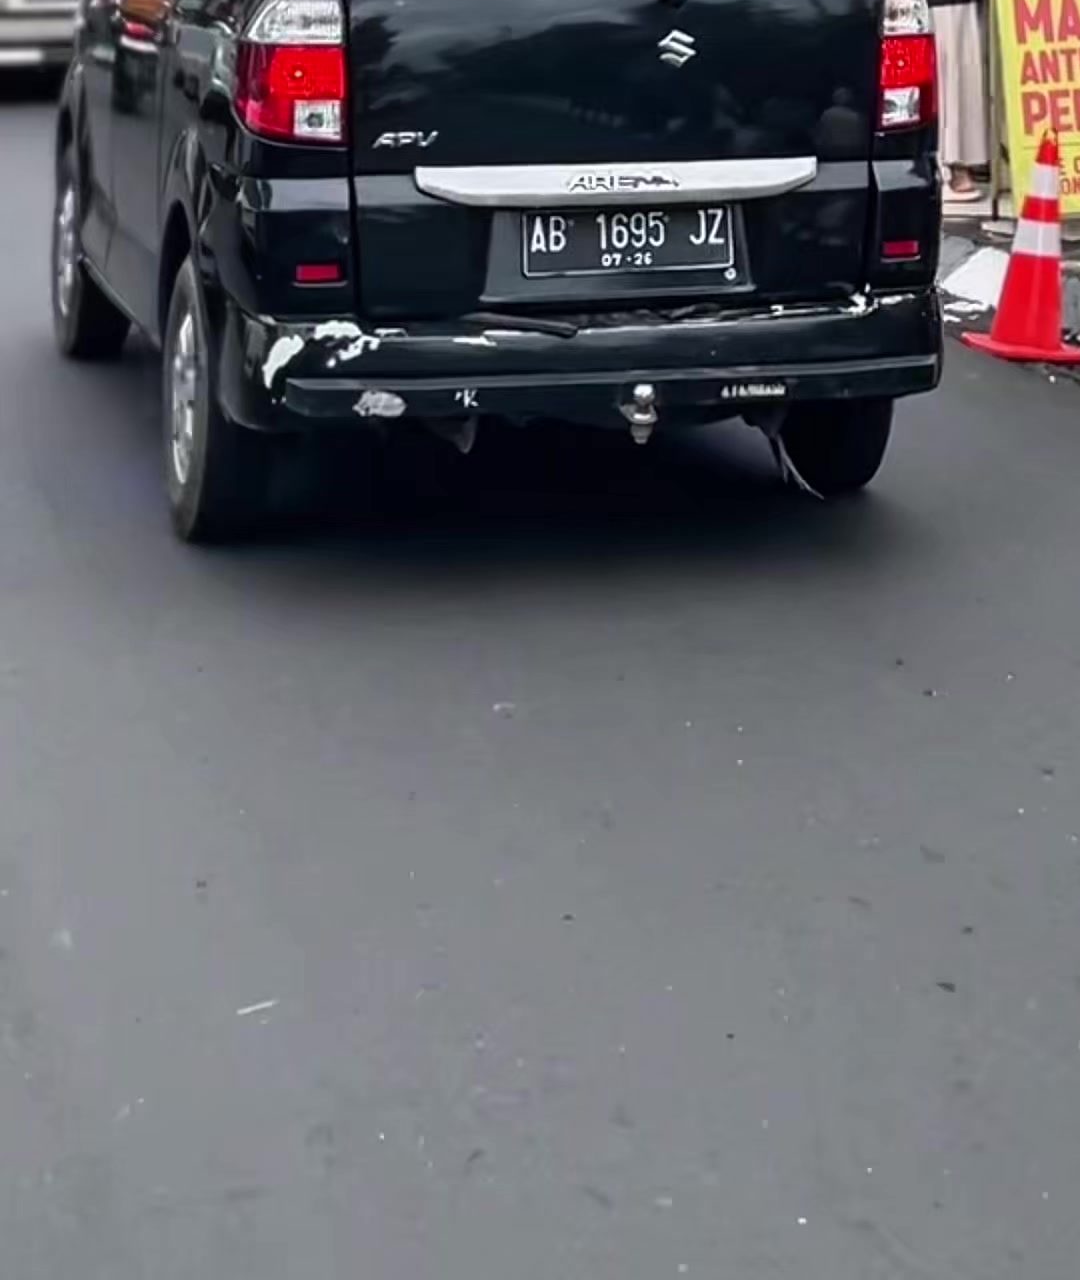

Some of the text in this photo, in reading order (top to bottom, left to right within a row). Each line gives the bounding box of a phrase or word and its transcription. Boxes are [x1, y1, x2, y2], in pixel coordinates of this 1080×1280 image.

[371, 129, 440, 149] APV
[531, 208, 726, 253] AB 1695 JZ
